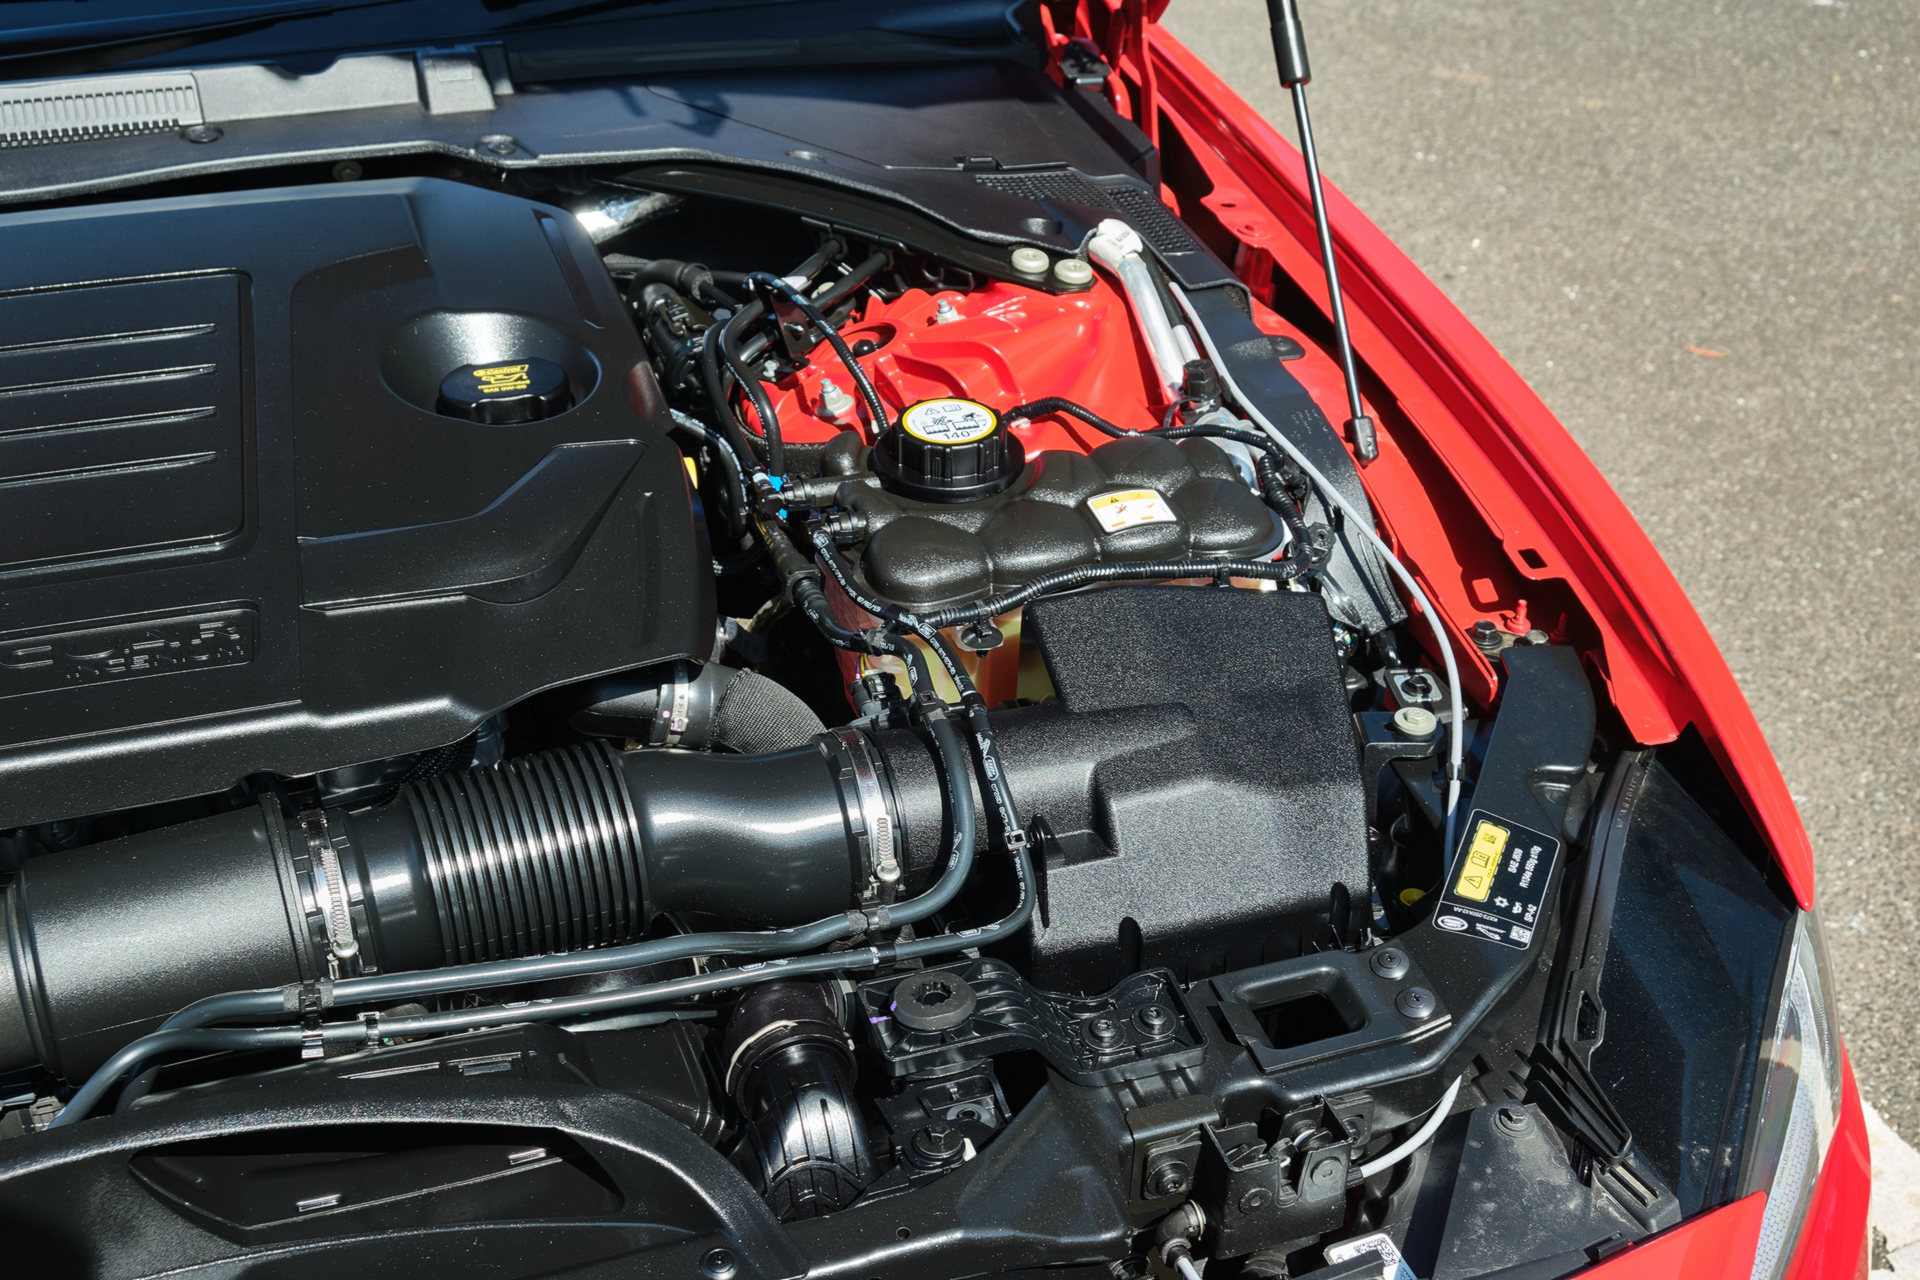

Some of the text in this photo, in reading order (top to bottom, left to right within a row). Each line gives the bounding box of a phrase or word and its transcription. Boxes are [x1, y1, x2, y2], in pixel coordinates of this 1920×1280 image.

[486, 366, 521, 376] Castrol
[943, 431, 970, 440] 140
[1508, 860, 1520, 874] SAE
[1776, 1166, 1785, 1188] JAGUAR
